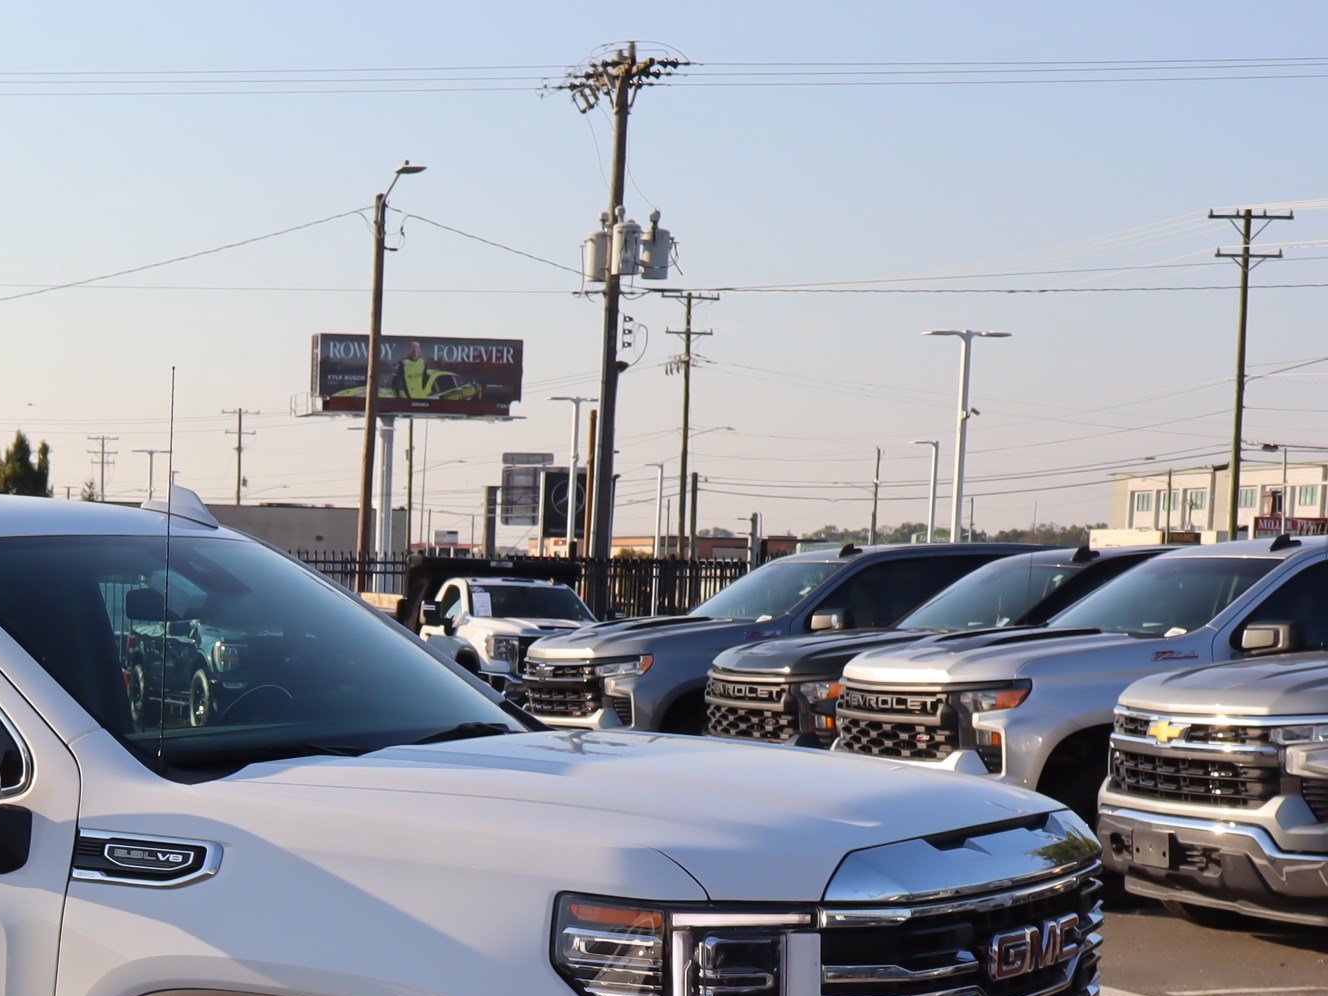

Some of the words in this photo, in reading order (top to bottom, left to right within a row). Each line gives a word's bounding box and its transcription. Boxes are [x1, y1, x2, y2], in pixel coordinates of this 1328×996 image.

[433, 344, 514, 364] FOREVER
[1258, 518, 1292, 530] MILLR
[156, 852, 183, 863] V8
[990, 912, 1079, 980] GMC
